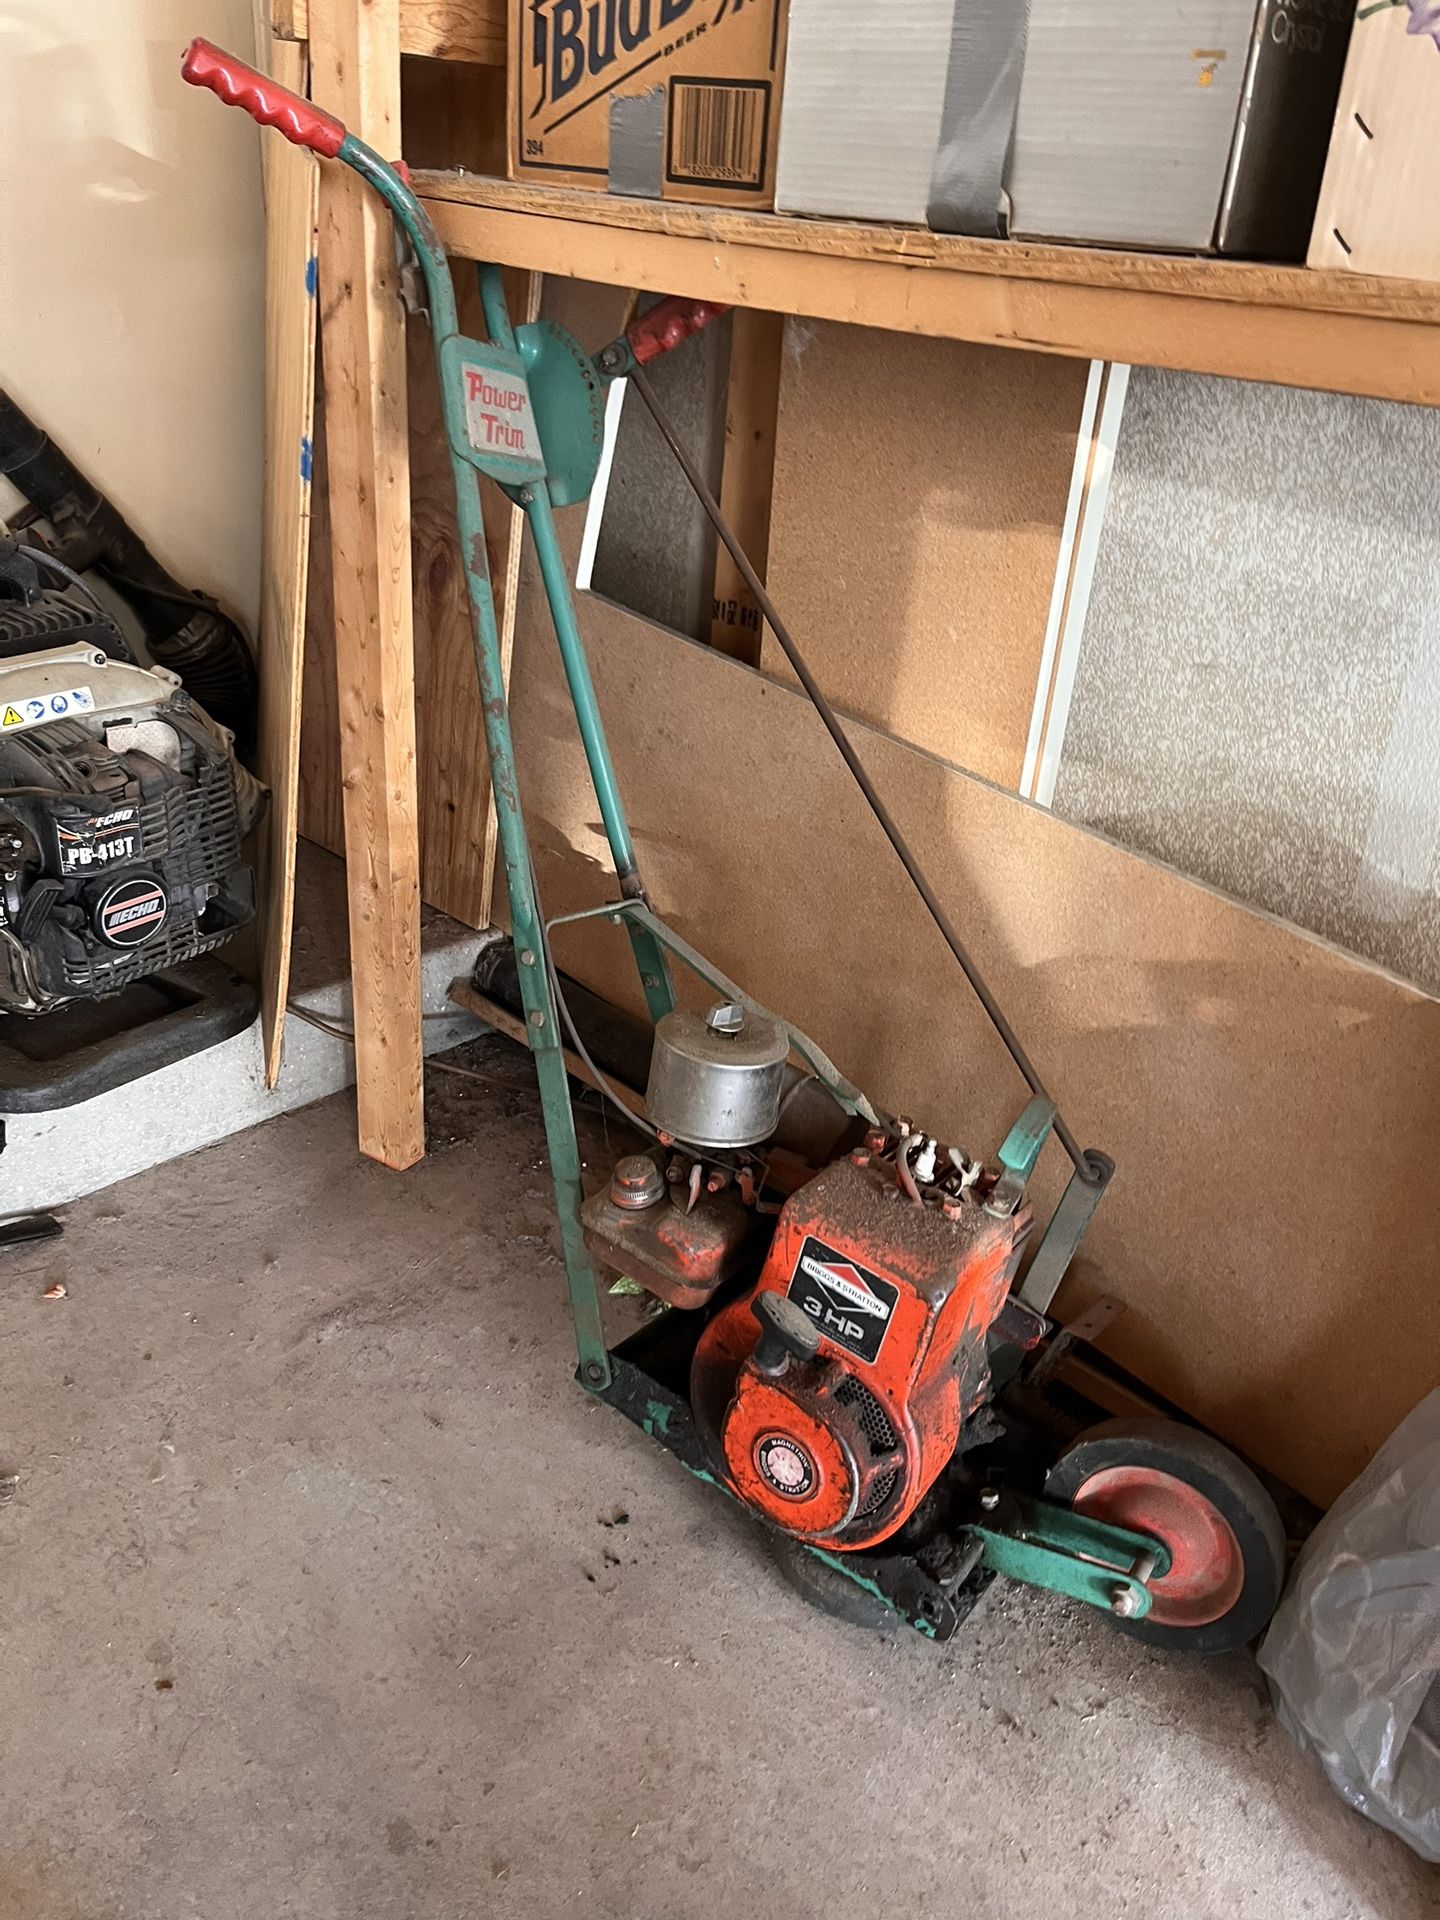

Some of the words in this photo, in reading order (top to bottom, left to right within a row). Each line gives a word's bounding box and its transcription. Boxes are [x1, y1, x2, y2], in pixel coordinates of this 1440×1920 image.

[465, 371, 527, 412] Power
[480, 413, 525, 449] Trim
[67, 836, 135, 866] PB-413T
[115, 899, 160, 926] ECHO
[806, 1262, 836, 1285] BRIGGS
[835, 1280, 842, 1288] &
[842, 1285, 882, 1314] STRATTON
[803, 1295, 823, 1318] 3
[824, 1308, 865, 1340] HP
